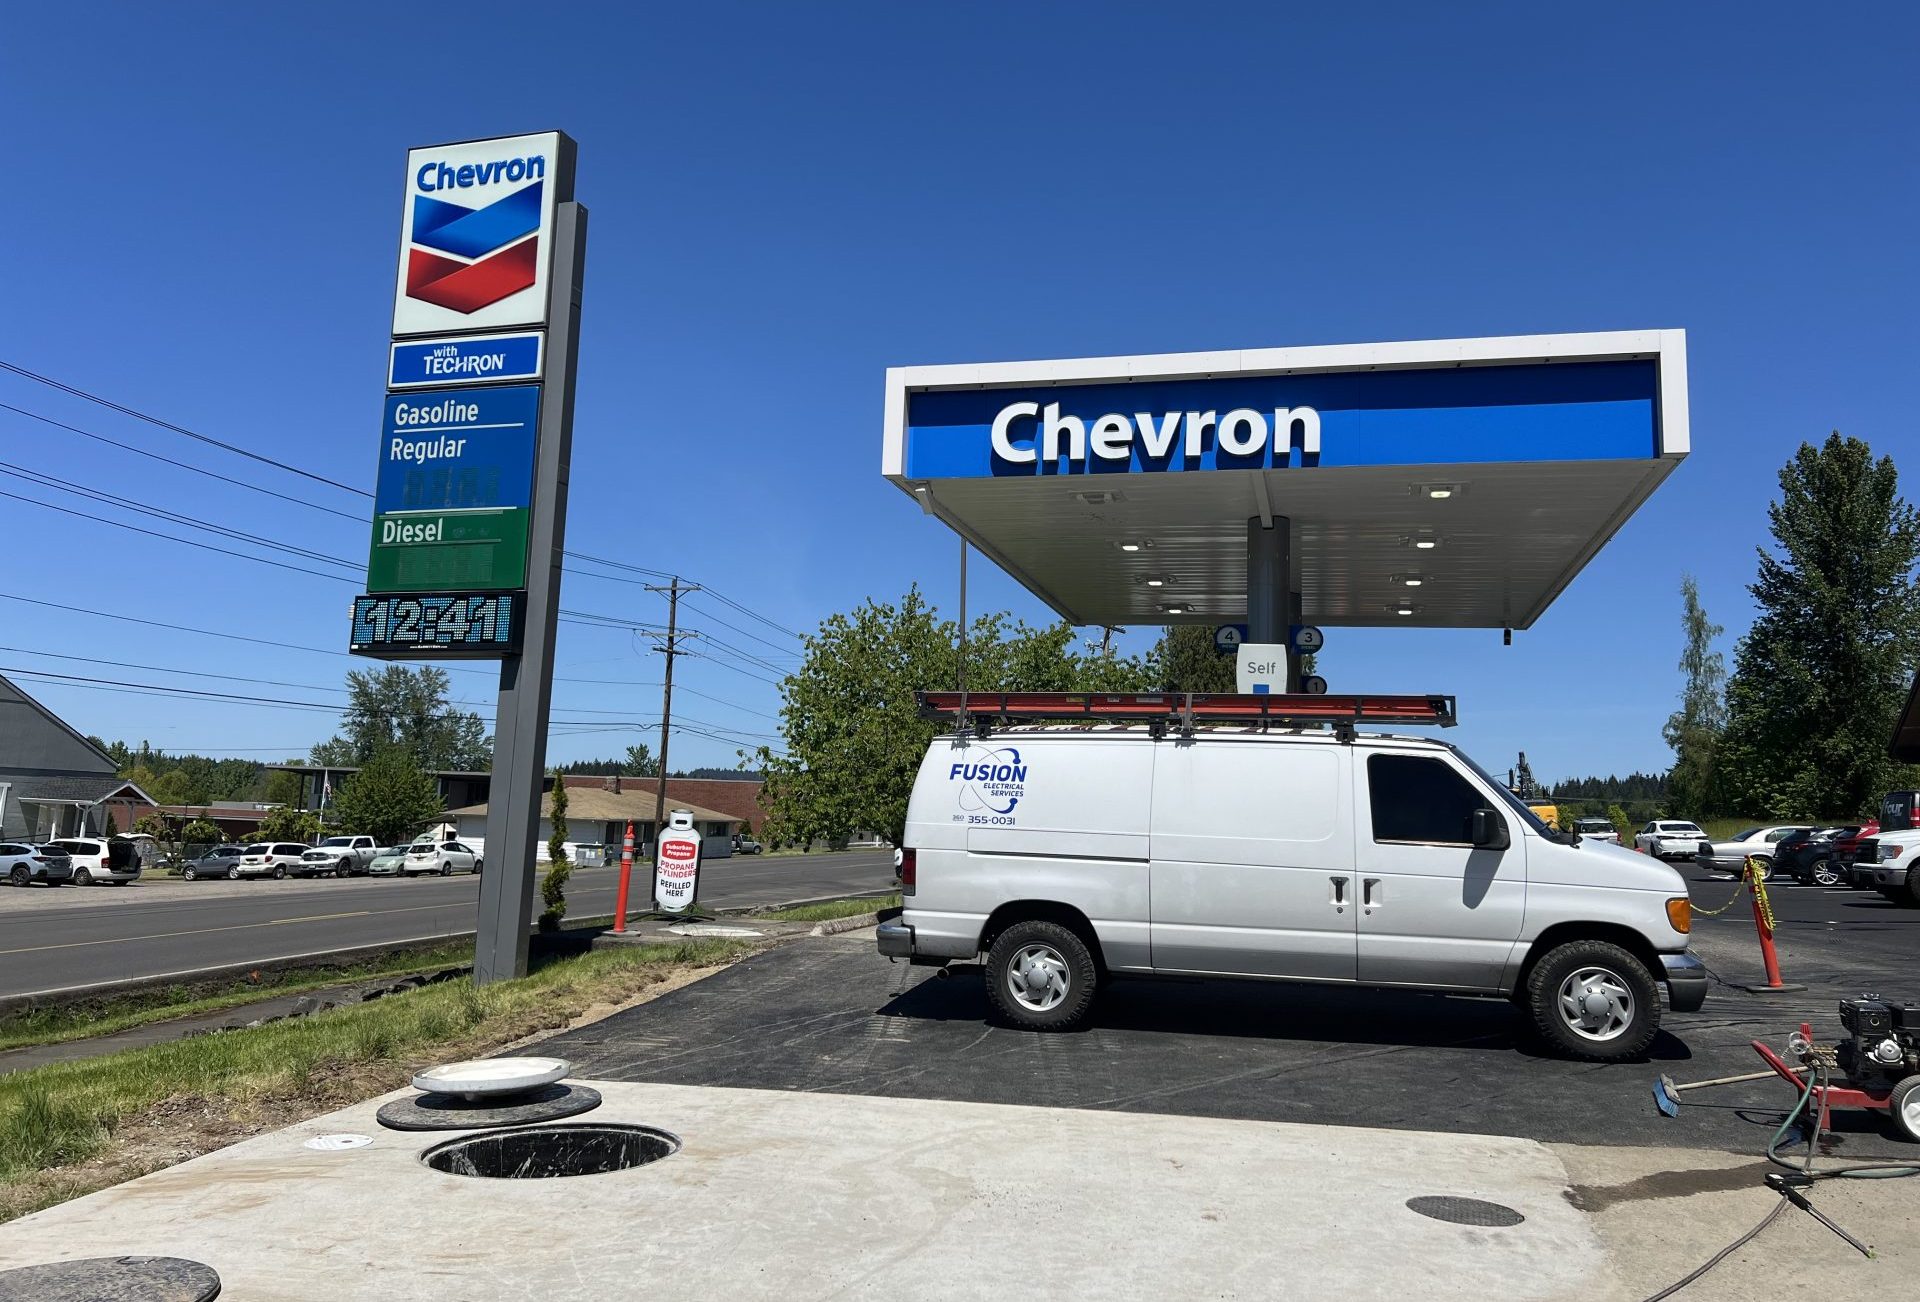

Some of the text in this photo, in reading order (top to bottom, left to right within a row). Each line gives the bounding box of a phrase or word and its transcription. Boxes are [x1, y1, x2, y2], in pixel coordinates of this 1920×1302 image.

[417, 155, 545, 192] Chevron
[433, 345, 458, 358] with
[423, 353, 504, 376] TECHRON
[395, 400, 479, 426] Gasoline
[991, 401, 1321, 464] Chevron
[390, 435, 467, 464] Regular
[383, 518, 443, 544] Diesel
[362, 598, 501, 642] 12:41
[1225, 631, 1234, 641] 4
[1304, 632, 1313, 643] 3
[1247, 661, 1277, 675] Self
[949, 763, 1028, 782] FUSION
[967, 815, 1016, 826] 355-0031
[657, 866, 697, 879] CYLINDERS
[660, 860, 695, 871] PROPANE
[660, 879, 691, 890] REFILLED
[665, 889, 684, 897] HERE
